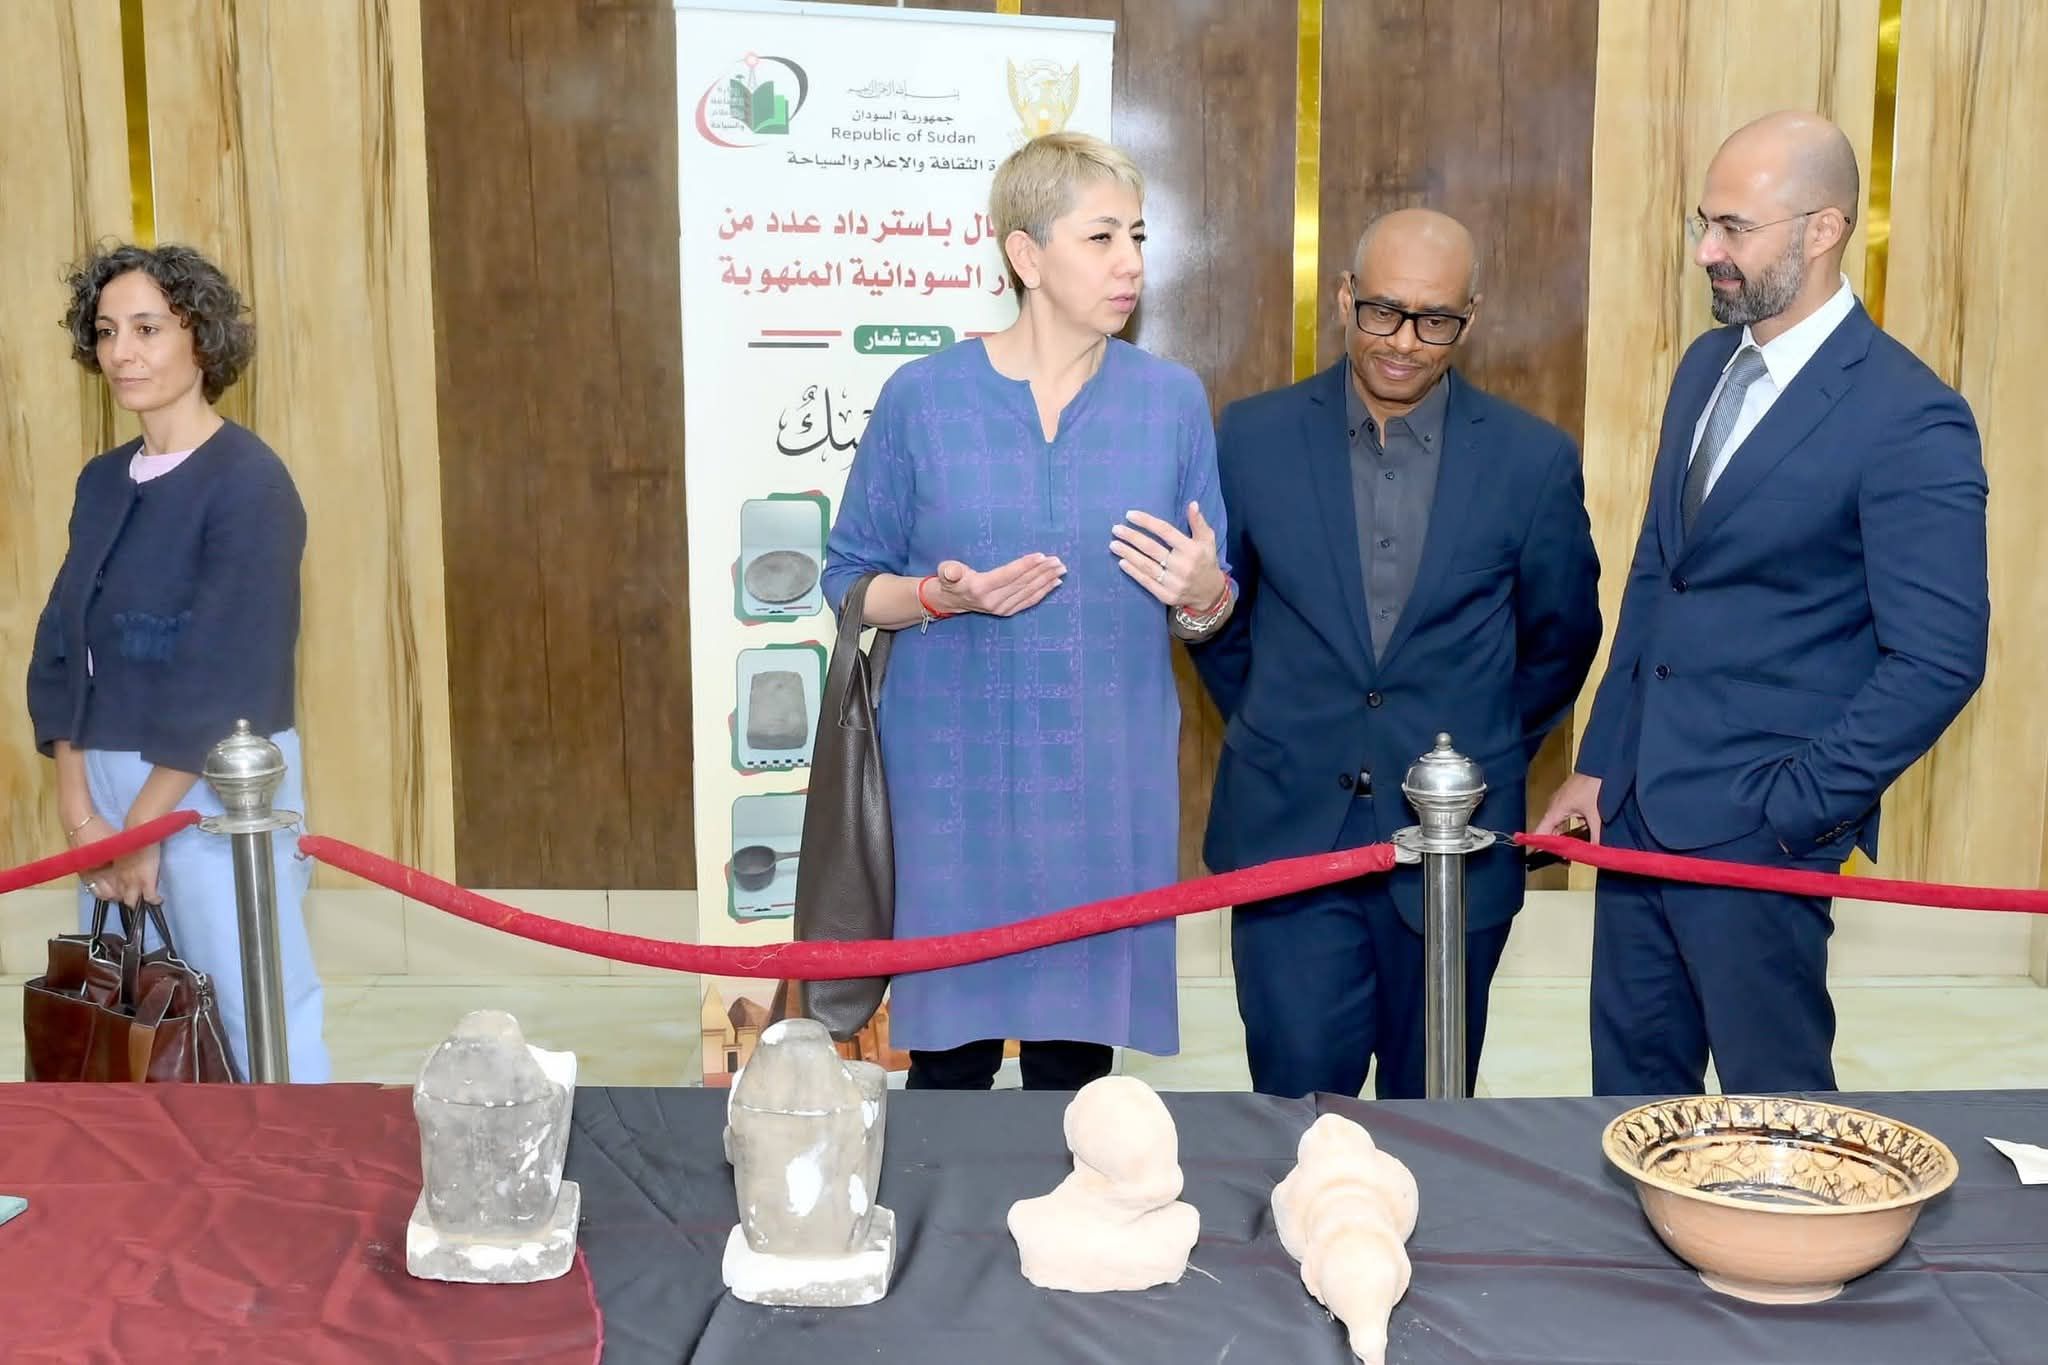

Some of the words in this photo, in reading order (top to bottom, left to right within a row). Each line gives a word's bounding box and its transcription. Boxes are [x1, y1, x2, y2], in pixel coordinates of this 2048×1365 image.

[852, 110, 897, 122] السودان
[902, 110, 954, 125] جمهورية
[832, 127, 901, 142] Republic
[906, 128, 923, 142] of
[928, 130, 976, 144] Sudan
[787, 152, 859, 170] والسياحة
[930, 155, 983, 170] الثقافة
[719, 207, 754, 240] من
[767, 211, 822, 233] عدد
[834, 209, 953, 247] باسترداد
[719, 256, 842, 296] المنهوبة
[849, 257, 982, 296] السودانية
[864, 328, 902, 350] شعار
[904, 329, 942, 347] تحت
